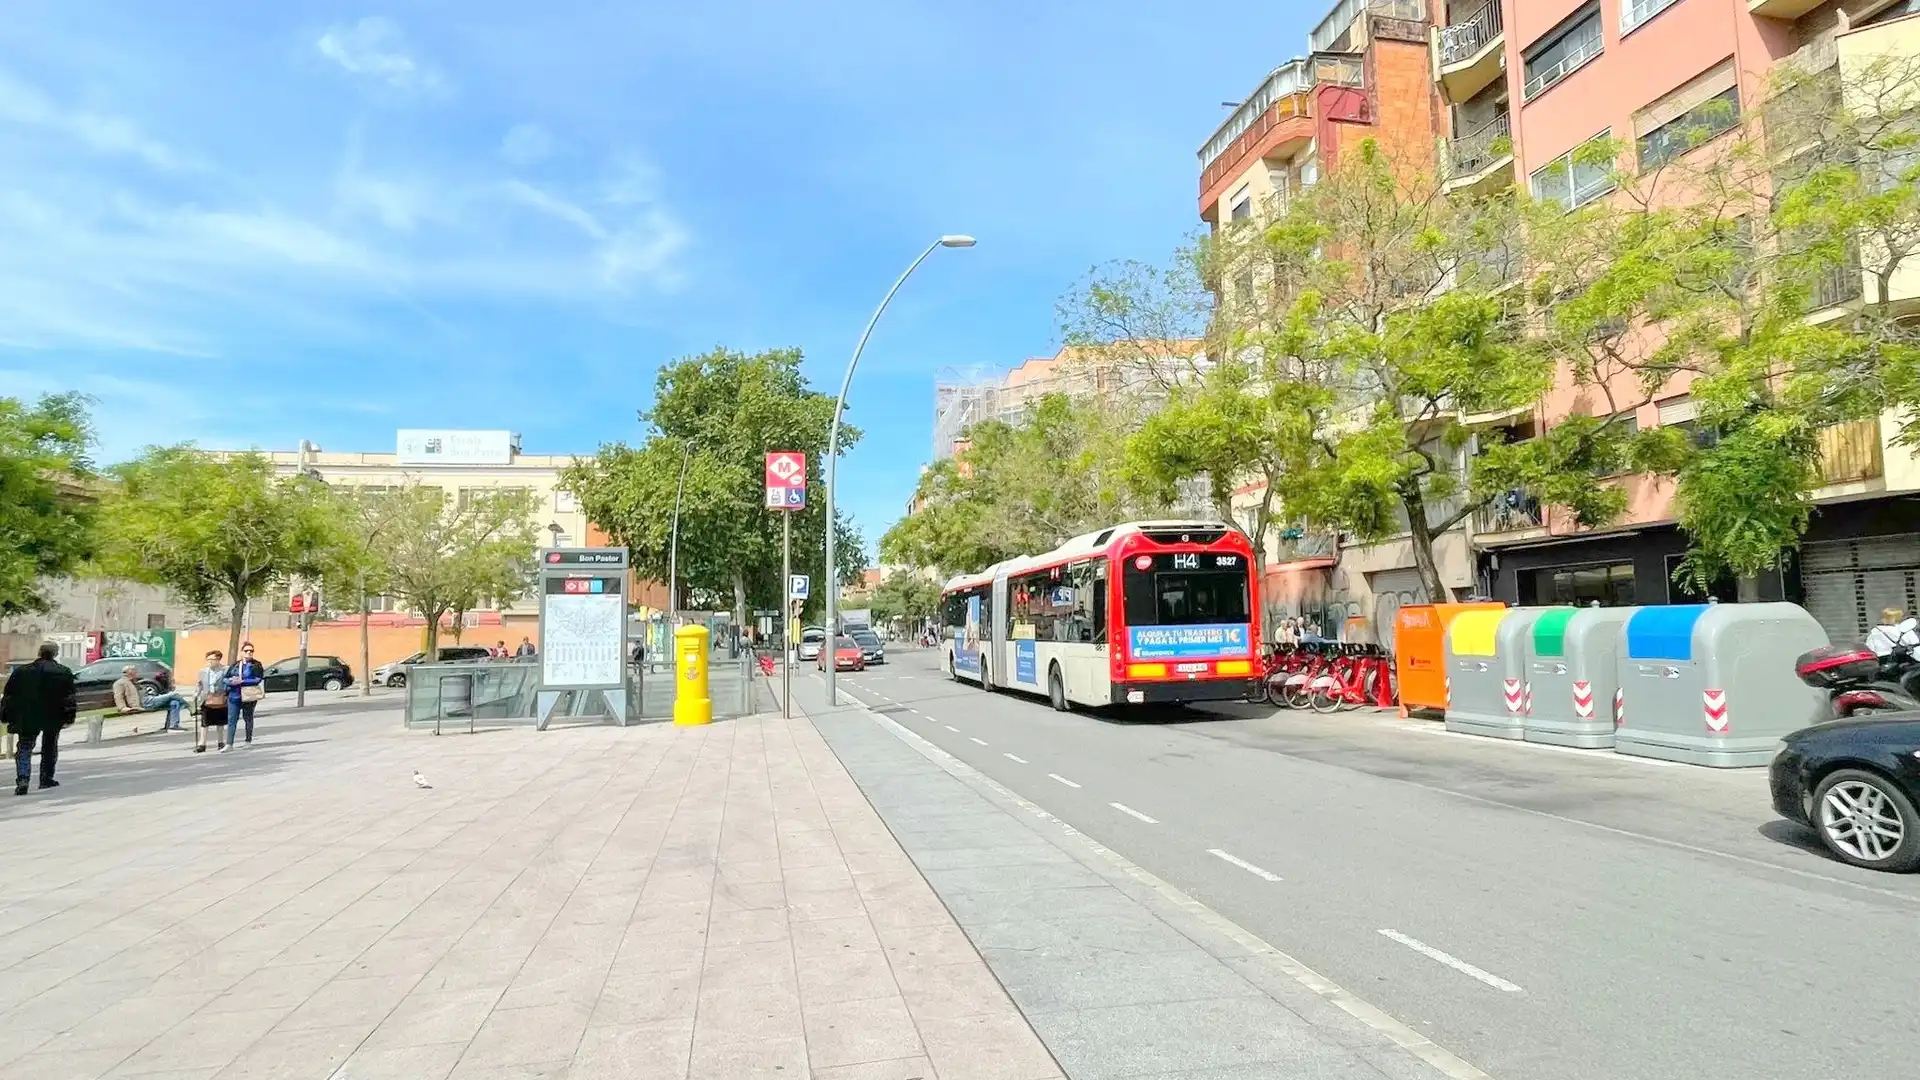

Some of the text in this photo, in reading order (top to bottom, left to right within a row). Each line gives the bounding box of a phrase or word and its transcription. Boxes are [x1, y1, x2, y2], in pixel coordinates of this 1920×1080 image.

[778, 462, 791, 473] M
[579, 554, 620, 562] Bon Pastor
[1174, 553, 1237, 569] H4 3527
[792, 577, 806, 594] P
[1136, 628, 1223, 638] ALQUILA TU TRASTERO
[1225, 628, 1241, 643] 1€
[1144, 637, 1168, 645] PAGA
[1168, 637, 1178, 645] EL
[1179, 636, 1206, 644] PRIMER
[1207, 635, 1223, 643] MES
